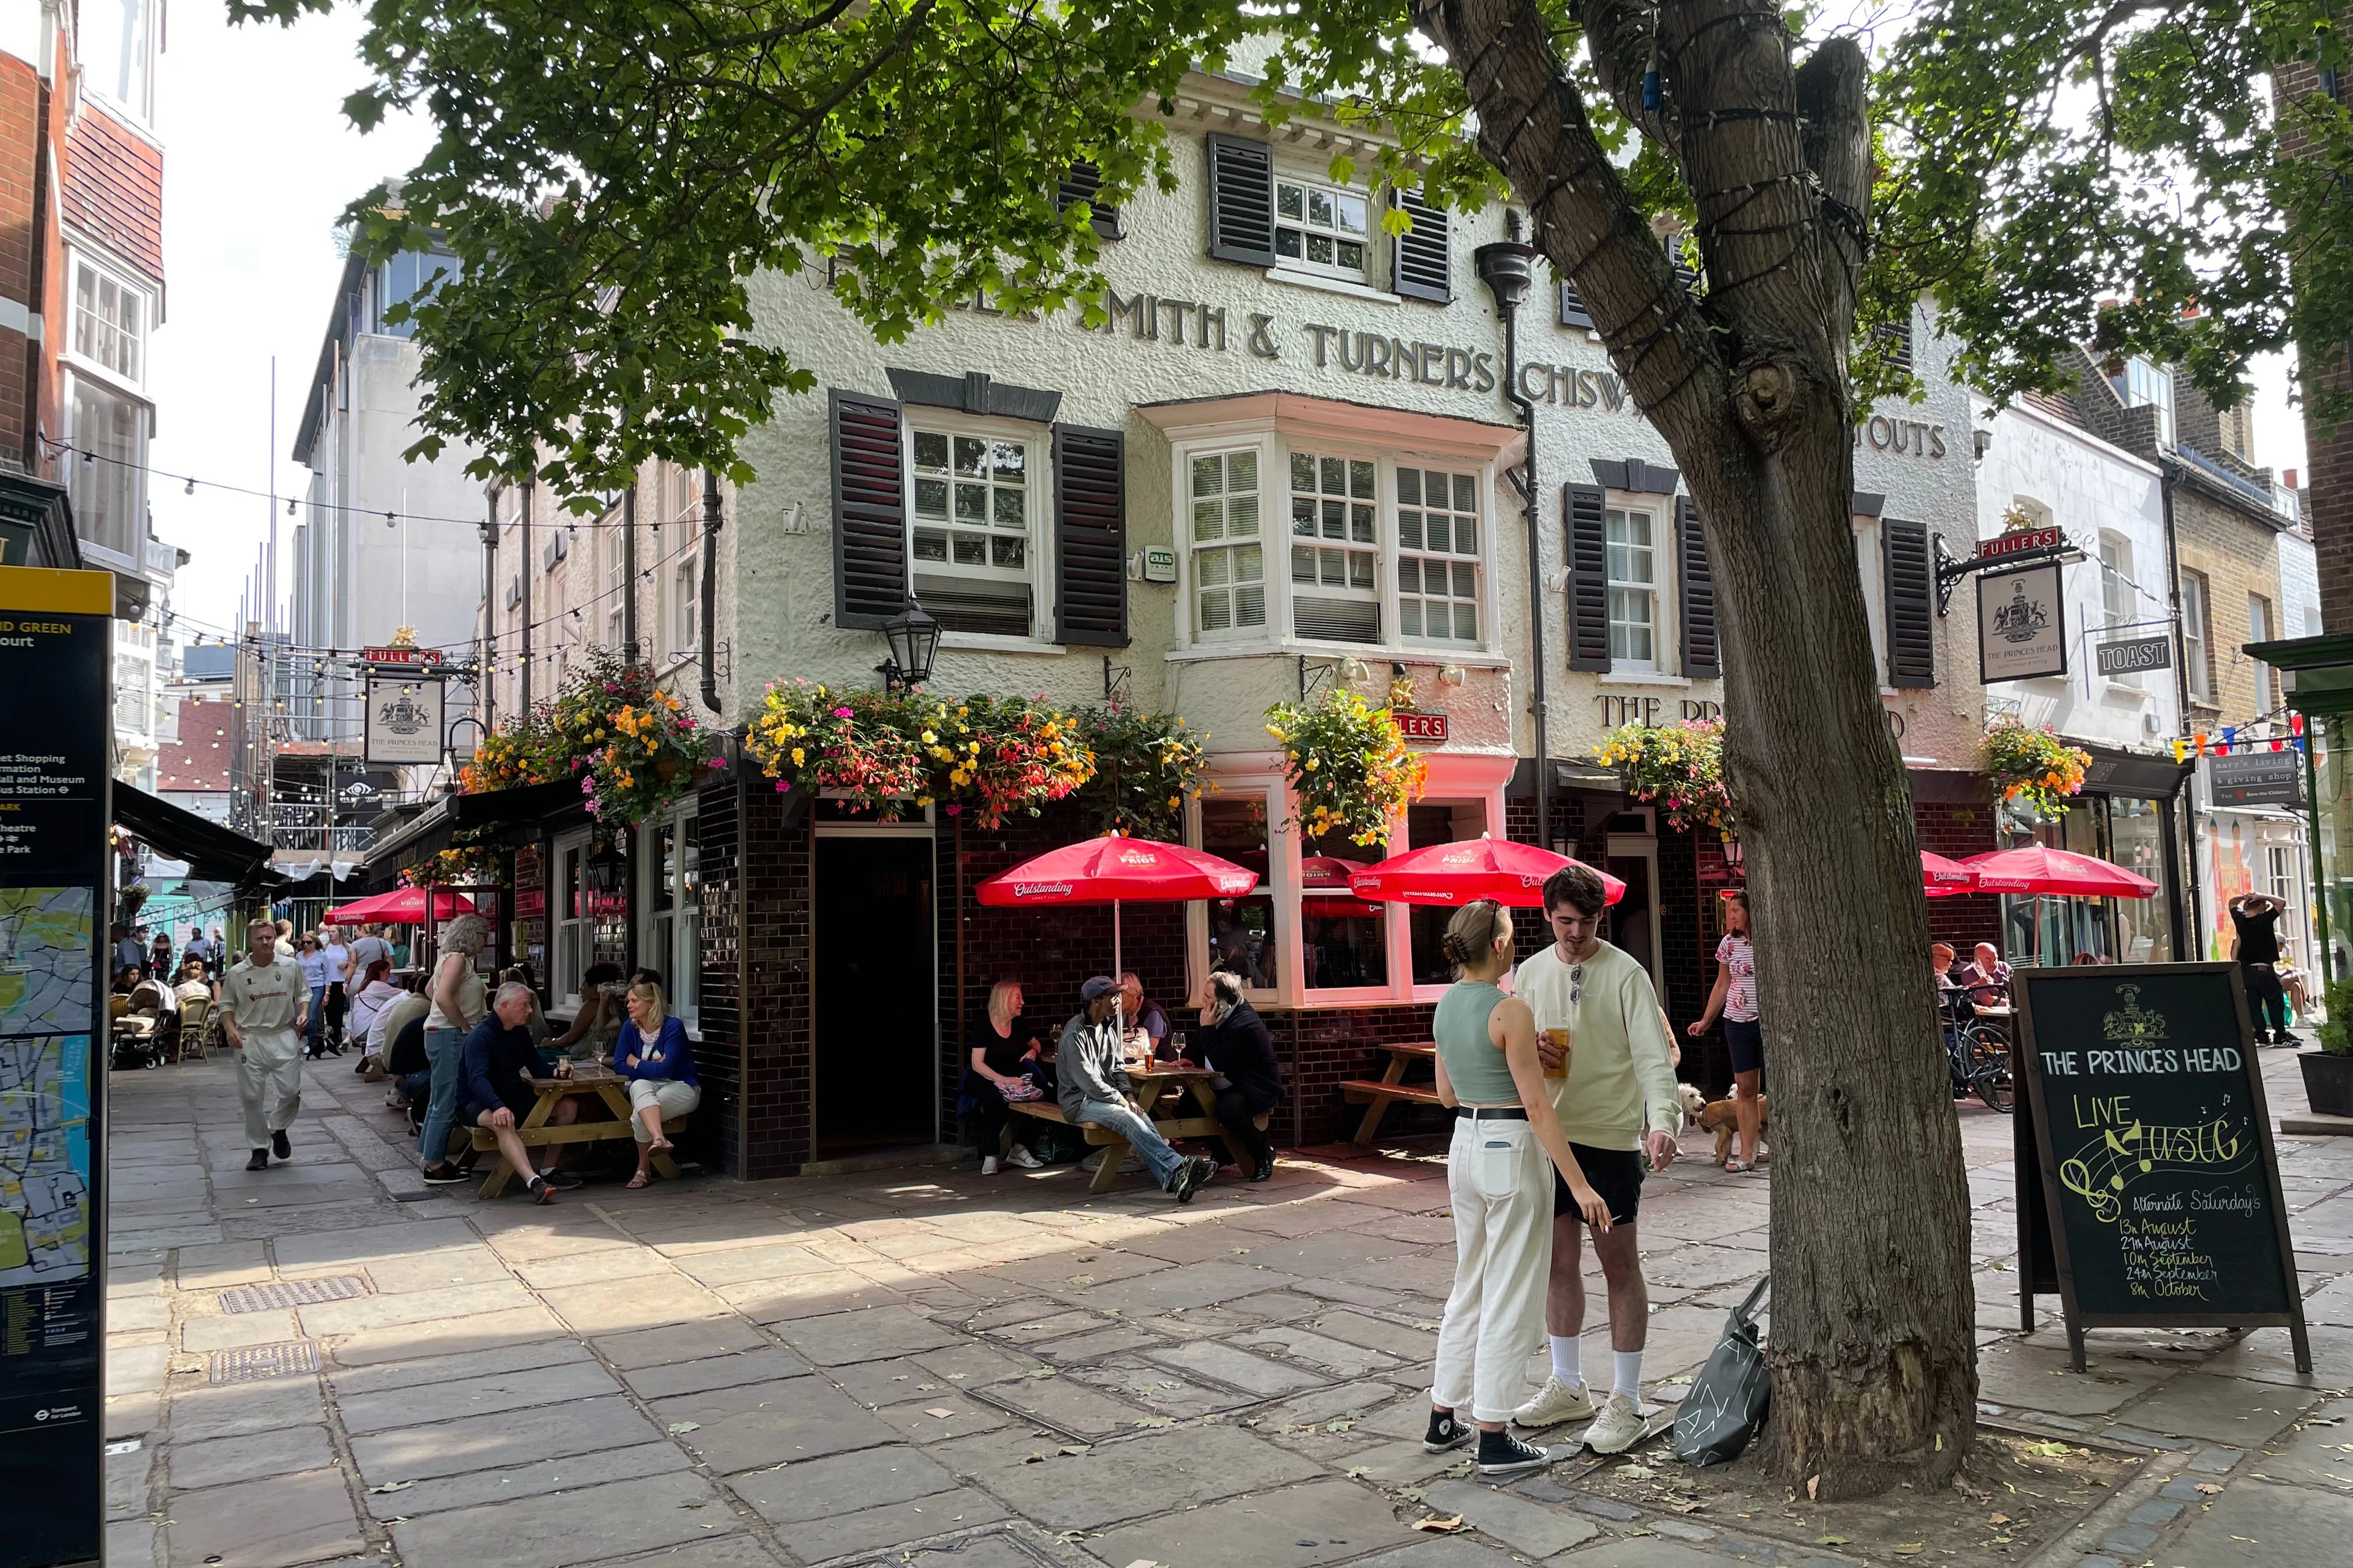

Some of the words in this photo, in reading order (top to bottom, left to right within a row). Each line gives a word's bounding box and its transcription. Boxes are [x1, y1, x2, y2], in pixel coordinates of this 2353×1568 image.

[1078, 288, 1228, 351] MITH
[1248, 313, 1282, 361] &
[1305, 323, 1496, 392] TURNER'S
[1520, 361, 1633, 413] CHISW
[1981, 532, 2052, 557] FULLER'S
[19, 622, 72, 634] GREEN
[0, 637, 34, 647] ourt
[1988, 652, 2001, 660] THE
[2004, 647, 2035, 658] PRINCES
[2037, 644, 2058, 654] HEAD
[2100, 642, 2166, 670] TOAST
[1593, 695, 1664, 729] THE
[15, 755, 65, 764] Shopping
[2216, 760, 2248, 769] mary's
[2255, 757, 2291, 766] living
[2228, 776, 2262, 785] giving
[1220, 876, 1251, 890] Outstanding
[1354, 876, 1382, 889] Outstanding
[1933, 871, 1971, 883] Outstanding
[1979, 878, 2030, 890] Outstanding
[1014, 881, 1073, 897] Outstanding
[2040, 1050, 2079, 1075] THE
[2087, 1049, 2180, 1075] PRINCE'S
[2184, 1048, 2242, 1074] HEAD
[2073, 1094, 2132, 1129] LIVE
[2141, 1217, 2197, 1240] August
[2145, 1234, 2194, 1256] August
[2149, 1252, 2213, 1269] September
[2153, 1265, 2218, 1284] September
[2155, 1279, 2210, 1301] October
